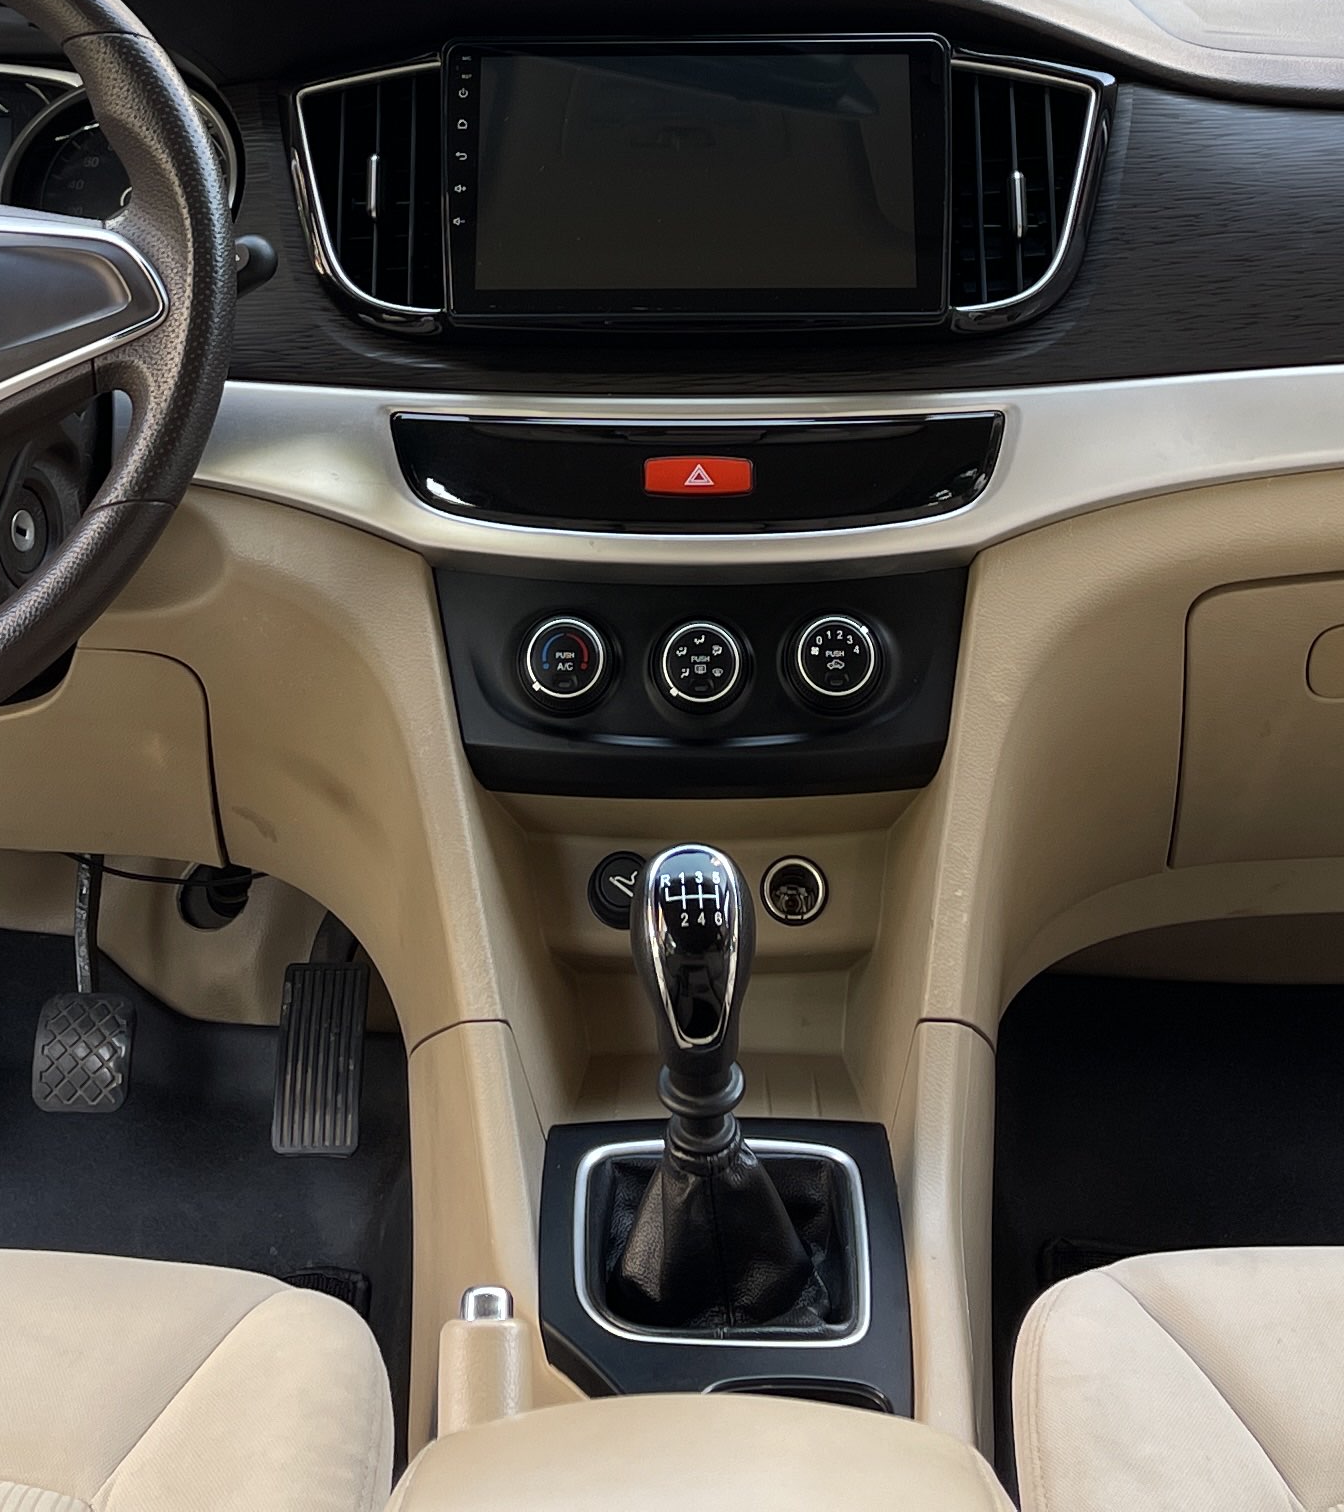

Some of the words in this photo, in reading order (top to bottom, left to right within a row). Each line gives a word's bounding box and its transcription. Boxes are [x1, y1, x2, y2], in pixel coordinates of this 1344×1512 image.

[815, 635, 823, 645] 0
[826, 630, 832, 639] 1
[836, 630, 843, 640] 2
[846, 634, 853, 644] 3
[853, 645, 860, 654] 4
[555, 651, 575, 659] PUSH
[825, 650, 845, 658] PUSH
[690, 655, 711, 663] PUSH
[556, 662, 574, 671] A/C
[660, 874, 671, 888] R
[678, 871, 685, 884] 1
[694, 870, 703, 884] 3
[711, 871, 721, 884] 5
[680, 912, 689, 927] 2
[697, 911, 706, 926] 4
[714, 911, 723, 926] 6
